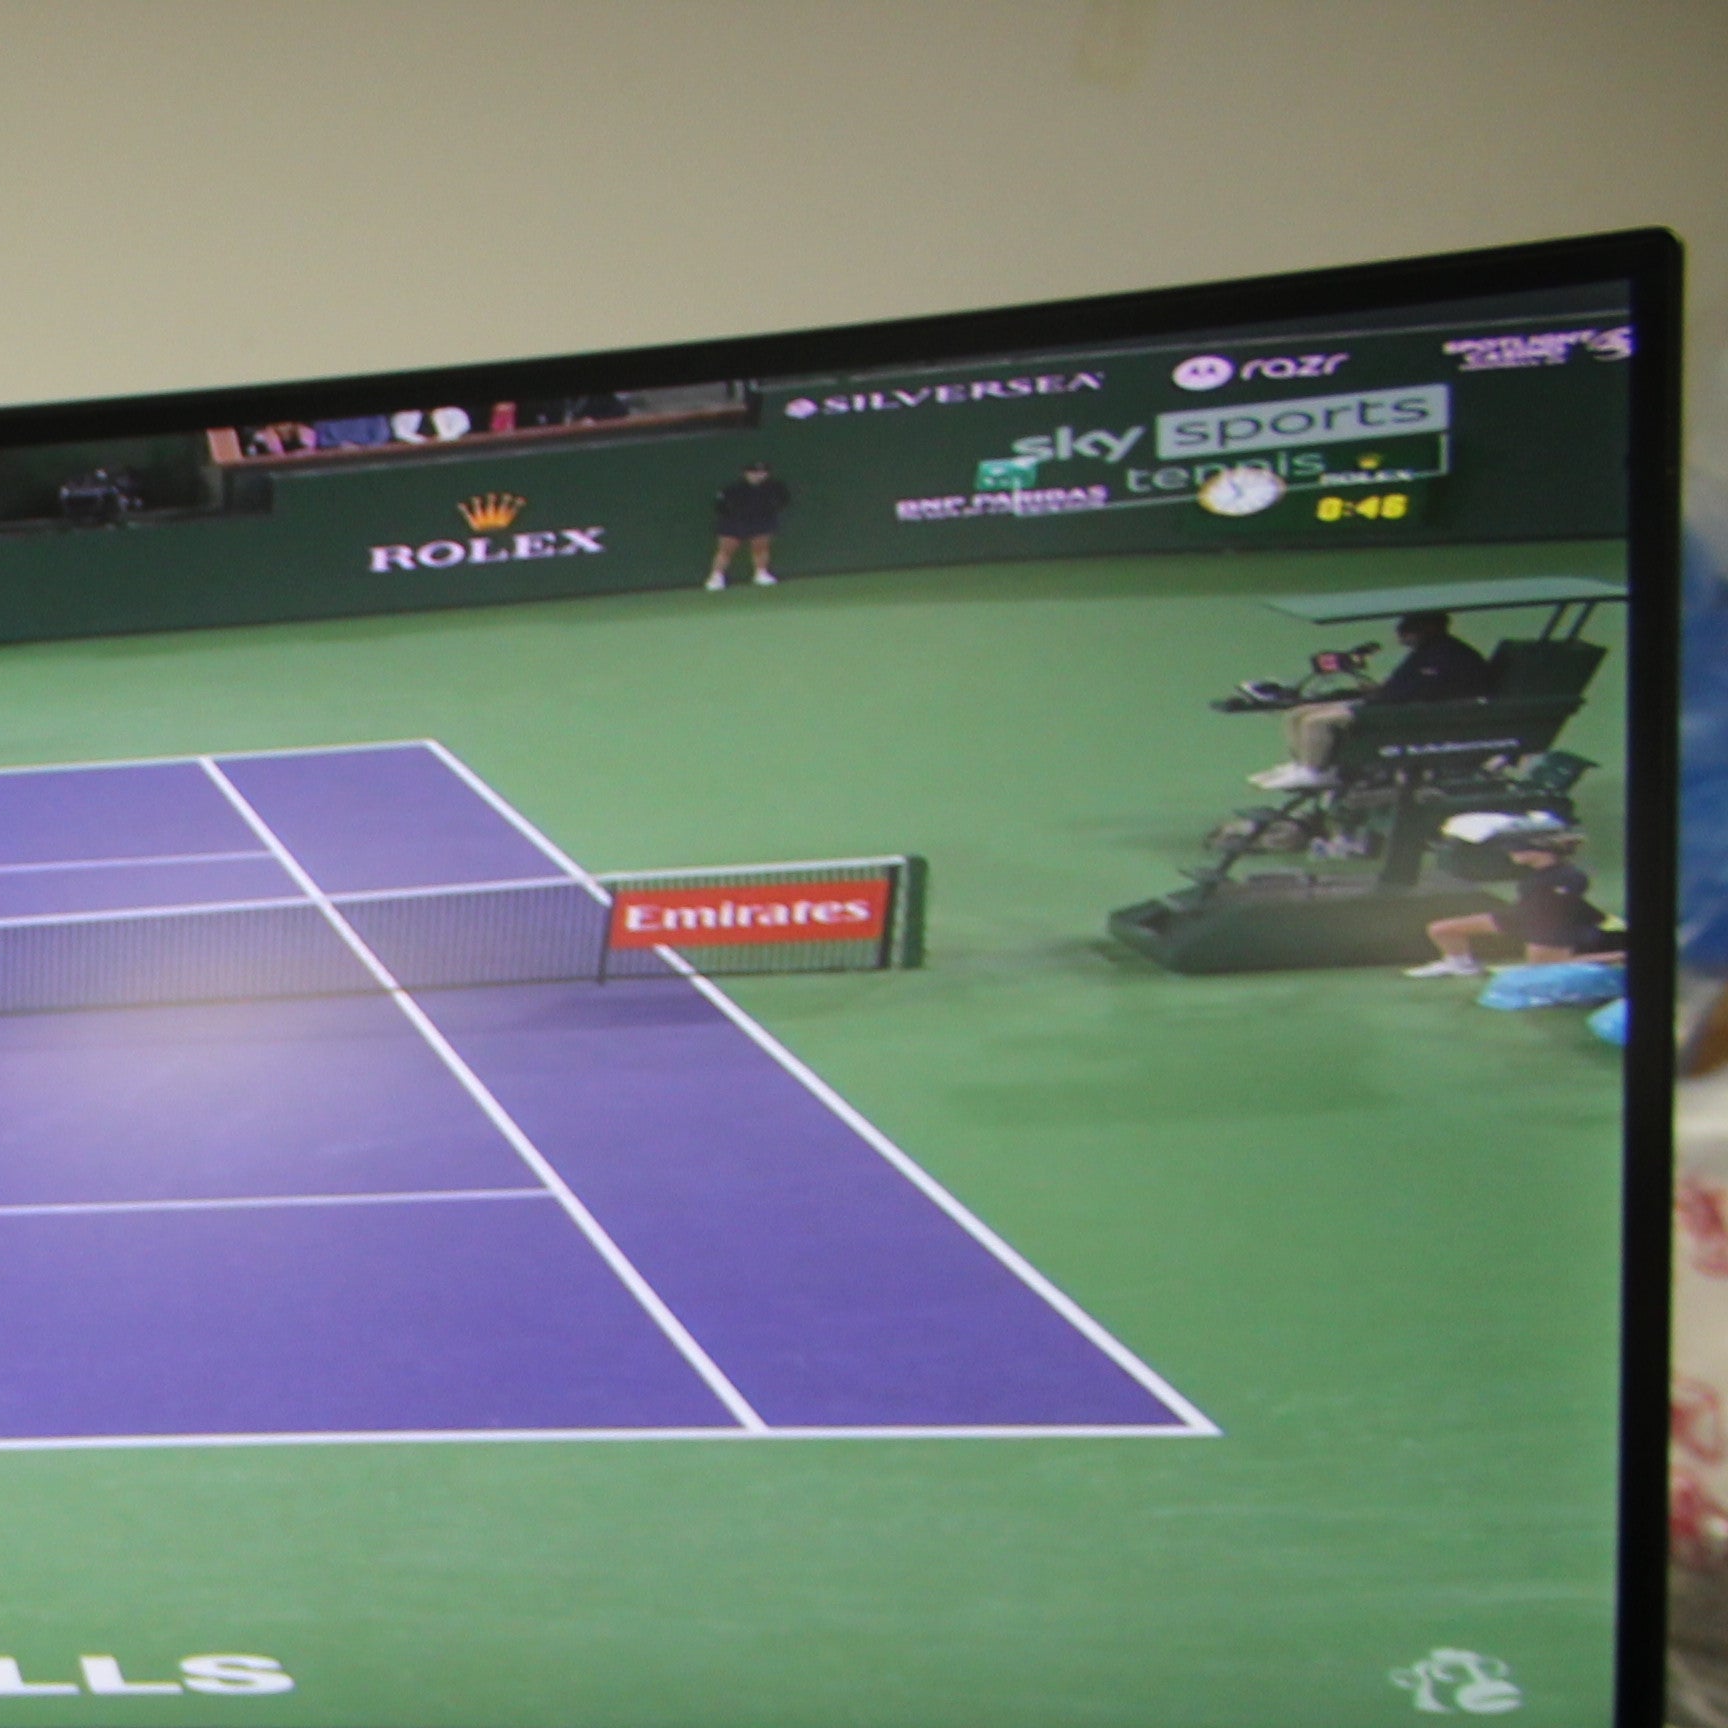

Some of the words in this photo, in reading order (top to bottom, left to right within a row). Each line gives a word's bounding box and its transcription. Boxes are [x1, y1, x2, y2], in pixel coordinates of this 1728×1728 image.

[1240, 353, 1351, 381] razr
[823, 372, 1102, 415] SILVERSEA
[1012, 426, 1145, 464] sky
[1174, 397, 1430, 448] sports
[369, 526, 606, 572] ROLEX
[624, 897, 872, 932] Emirates
